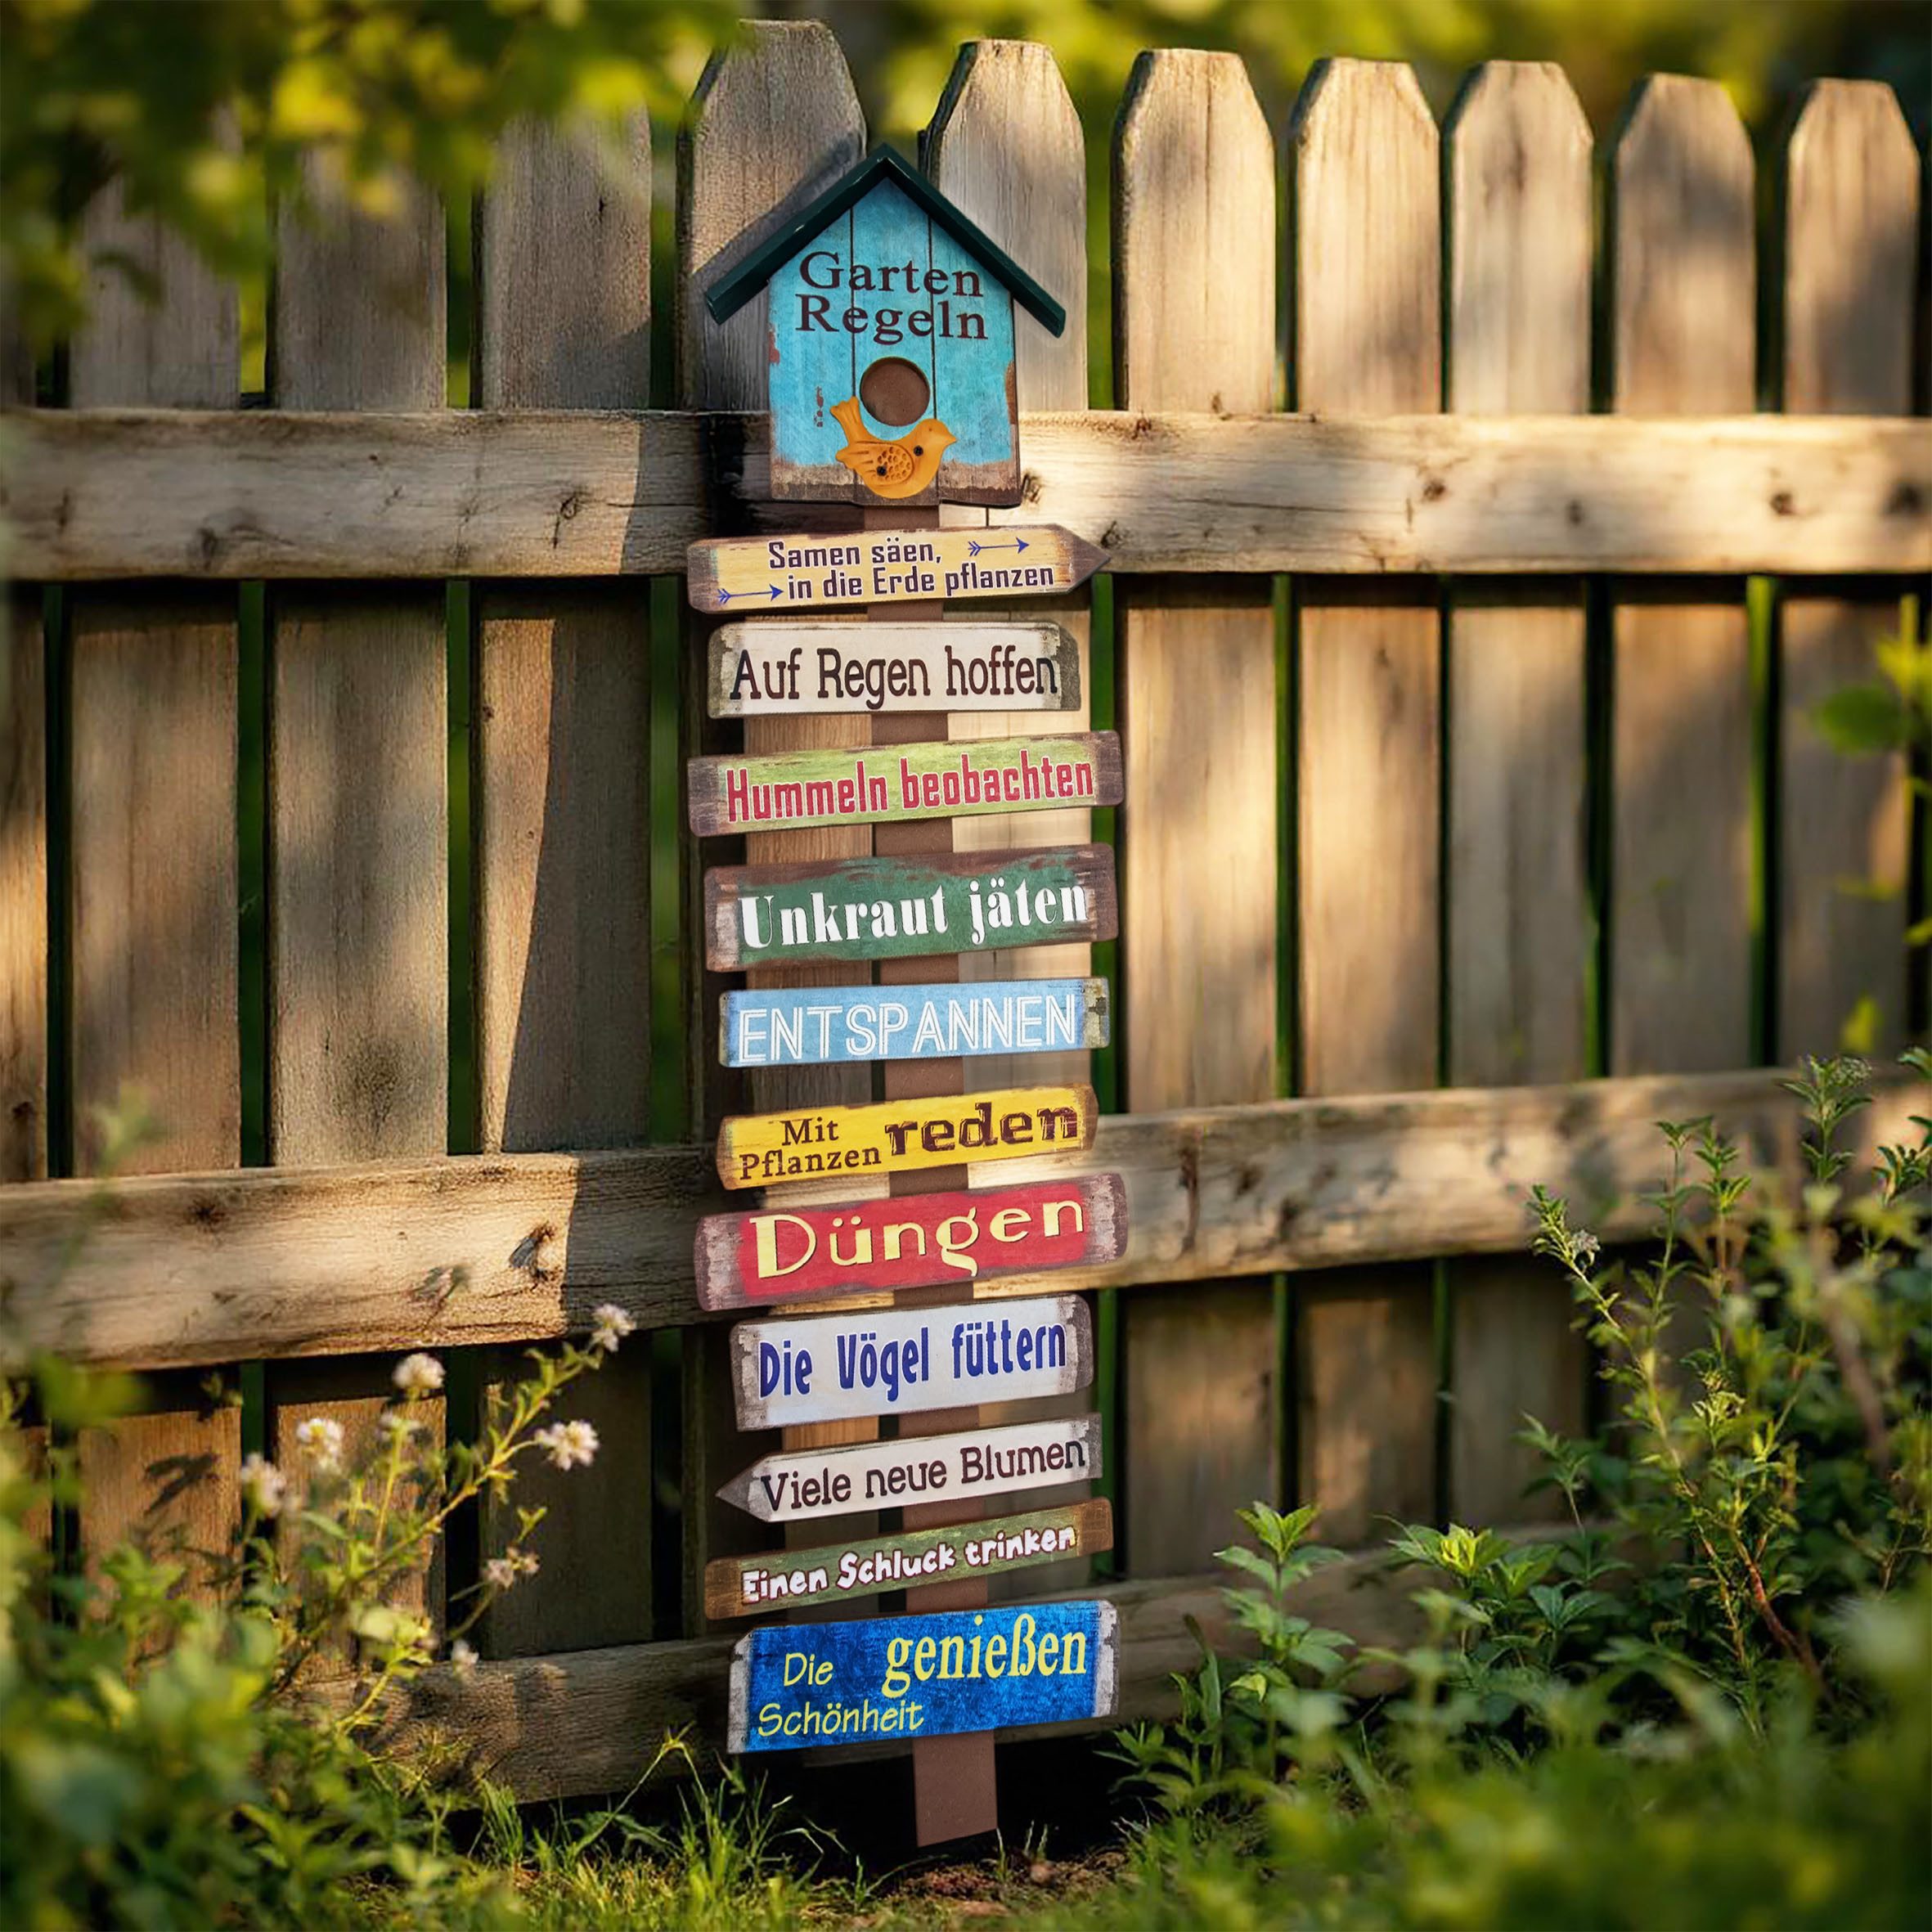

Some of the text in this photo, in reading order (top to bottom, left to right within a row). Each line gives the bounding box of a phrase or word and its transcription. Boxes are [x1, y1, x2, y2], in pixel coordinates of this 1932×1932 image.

[799, 251, 983, 298] Garten
[795, 293, 988, 345] Regeln
[768, 537, 941, 569] Samen säen,
[787, 564, 1054, 599] in die Erde pflanzen
[730, 645, 1058, 709] Auf Regen hoffen
[726, 749, 1094, 822] Hummeln beobachten
[738, 878, 1089, 948] Unkraut jäten
[738, 995, 1076, 1063] ENTSPANNEN
[781, 1117, 839, 1146] Mit
[885, 1103, 1079, 1157] reden
[739, 1149, 882, 1180] Pflanzen
[749, 1200, 1084, 1278] Düngen
[758, 1319, 1067, 1402] Die Vögel füttern
[761, 1440, 1085, 1511] Viele neue Blumen
[742, 1525, 1076, 1604] Einen Schluck trinken
[783, 1652, 833, 1687] Die
[882, 1613, 1086, 1697] genießen
[757, 1699, 924, 1737] Schönheit
